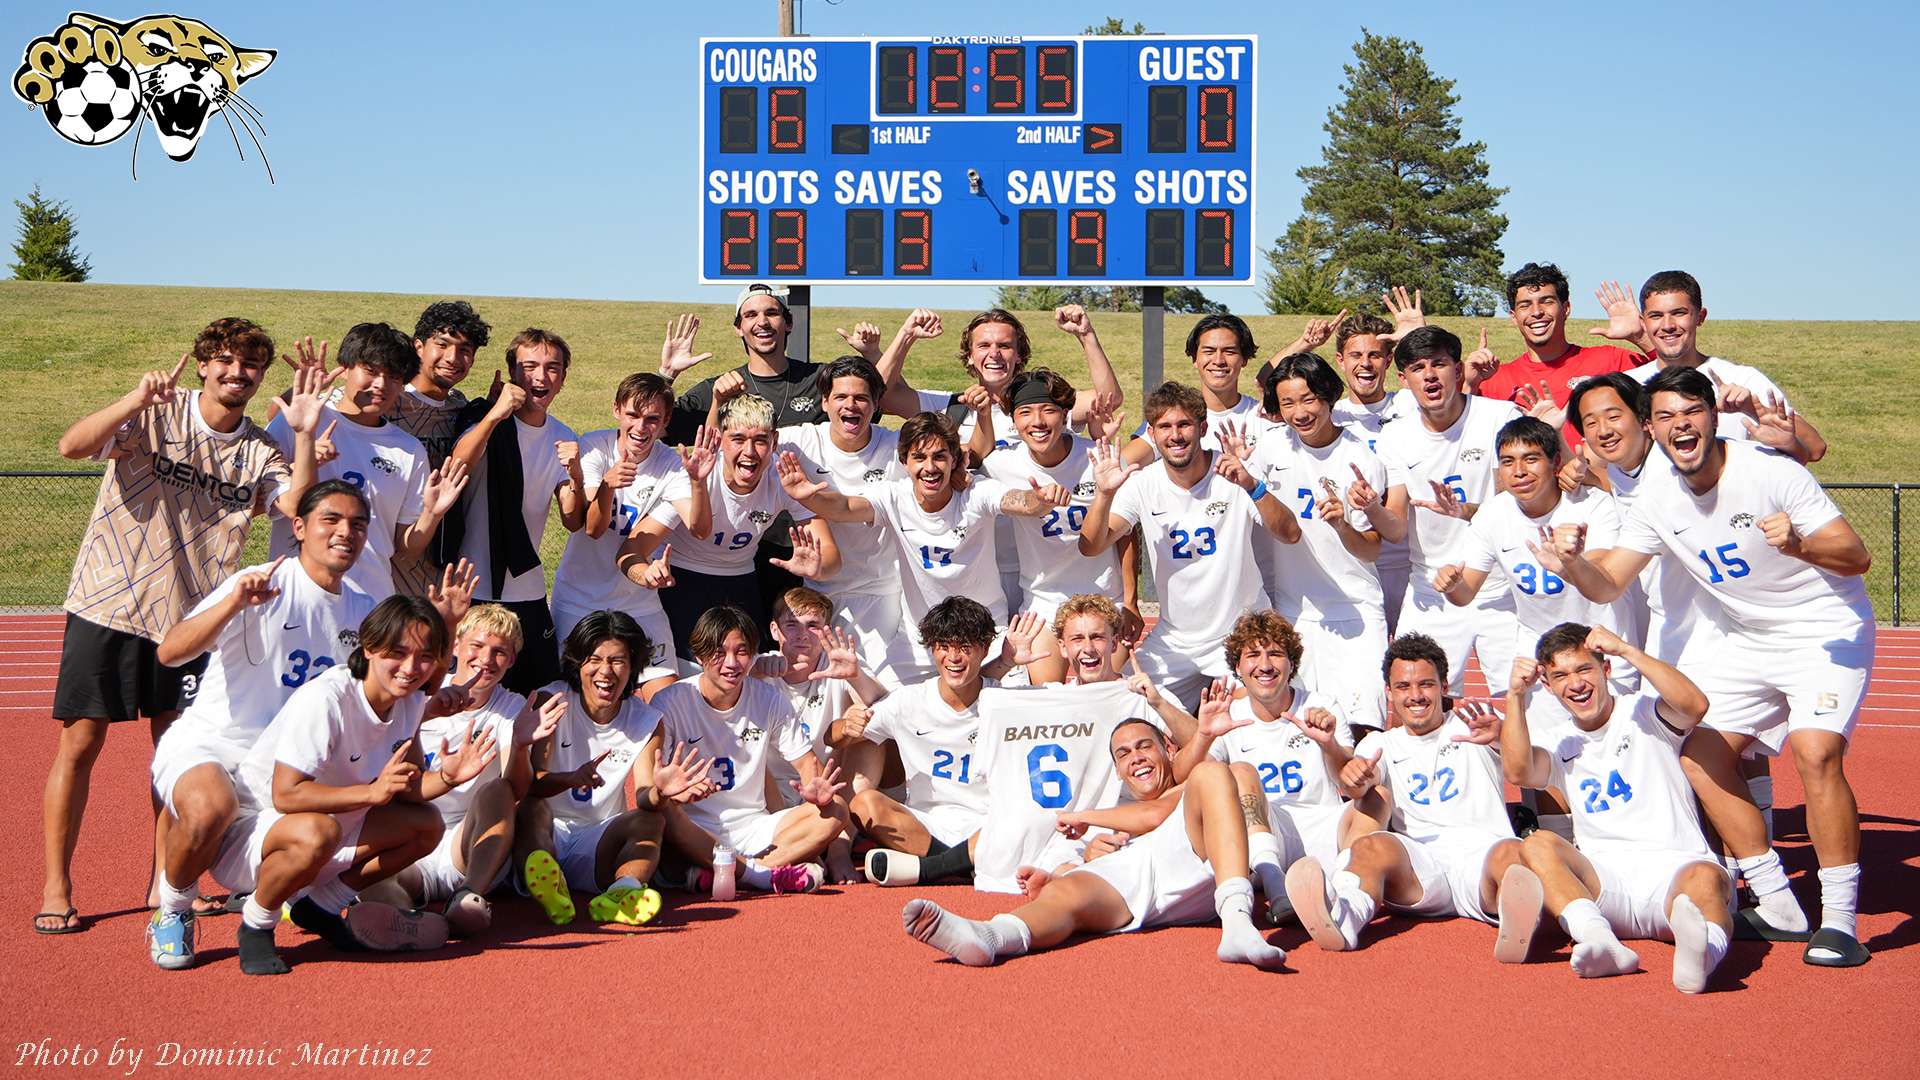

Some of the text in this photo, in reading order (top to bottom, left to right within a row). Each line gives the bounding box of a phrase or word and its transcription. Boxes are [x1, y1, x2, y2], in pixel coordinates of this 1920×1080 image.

[932, 36, 1021, 45] DAKTRONICS
[710, 48, 817, 82] COUGARS
[907, 48, 1071, 108] 12:55
[1139, 46, 1246, 81] GUEST
[771, 89, 804, 148] 6
[872, 126, 930, 144] 1st HALF
[1017, 126, 1081, 144] 2nd HALF
[1200, 88, 1233, 148] 0
[708, 169, 819, 204] SHOTS
[834, 169, 943, 204] SAVES
[1007, 169, 1117, 205] SAVES
[1134, 169, 1248, 205] SHOTS
[723, 211, 805, 270] 23
[899, 211, 929, 270] 3
[1071, 211, 1104, 268] 9
[1201, 211, 1231, 268] 7
[1041, 505, 1088, 537] 20
[714, 531, 753, 550] 19
[920, 544, 954, 569] 17
[1169, 526, 1217, 559] 23
[1513, 562, 1565, 596] 36
[1699, 542, 1751, 584] 15
[1004, 722, 1095, 742] BARTON
[932, 749, 971, 784] 21
[1027, 744, 1073, 808] 6
[1258, 760, 1303, 793] 26
[1408, 767, 1459, 805] 22
[1580, 769, 1633, 813] 24
